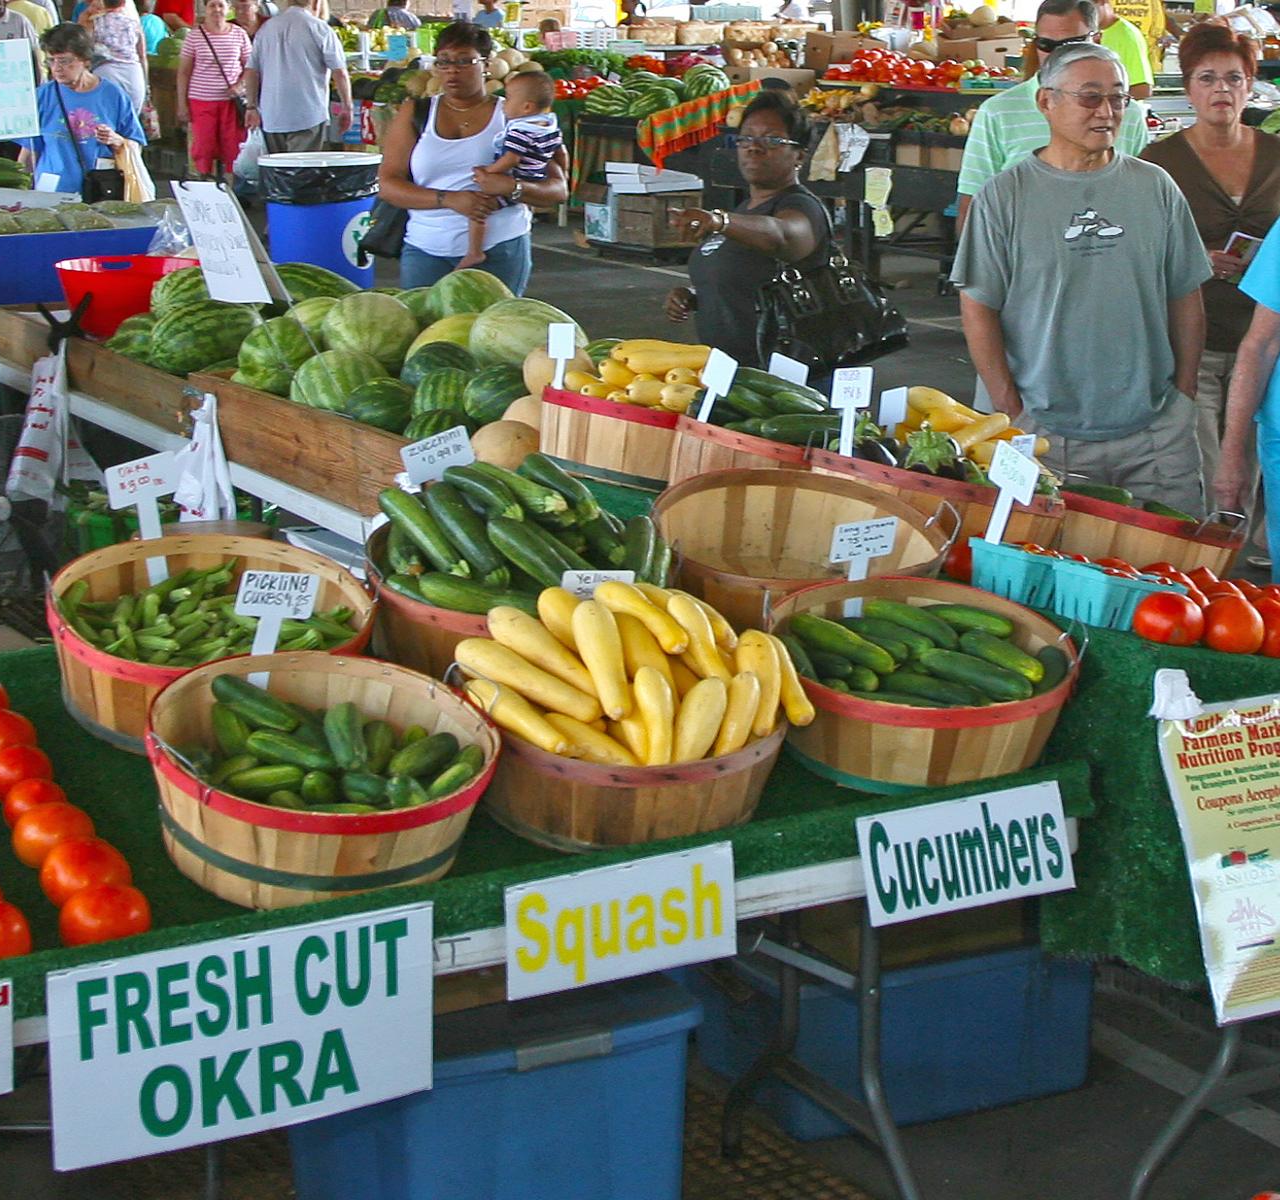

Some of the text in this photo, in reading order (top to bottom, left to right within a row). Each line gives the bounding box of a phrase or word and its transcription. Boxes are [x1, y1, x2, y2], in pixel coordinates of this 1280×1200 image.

[1176, 747, 1245, 770] Nutrition
[1181, 730, 1243, 751] Farmers
[1196, 793, 1244, 811] Coupons
[868, 802, 1066, 916] Cucumbers
[514, 862, 723, 985] Squash
[76, 917, 409, 1061] FRESH CUT
[137, 1027, 361, 1138] OKRA
